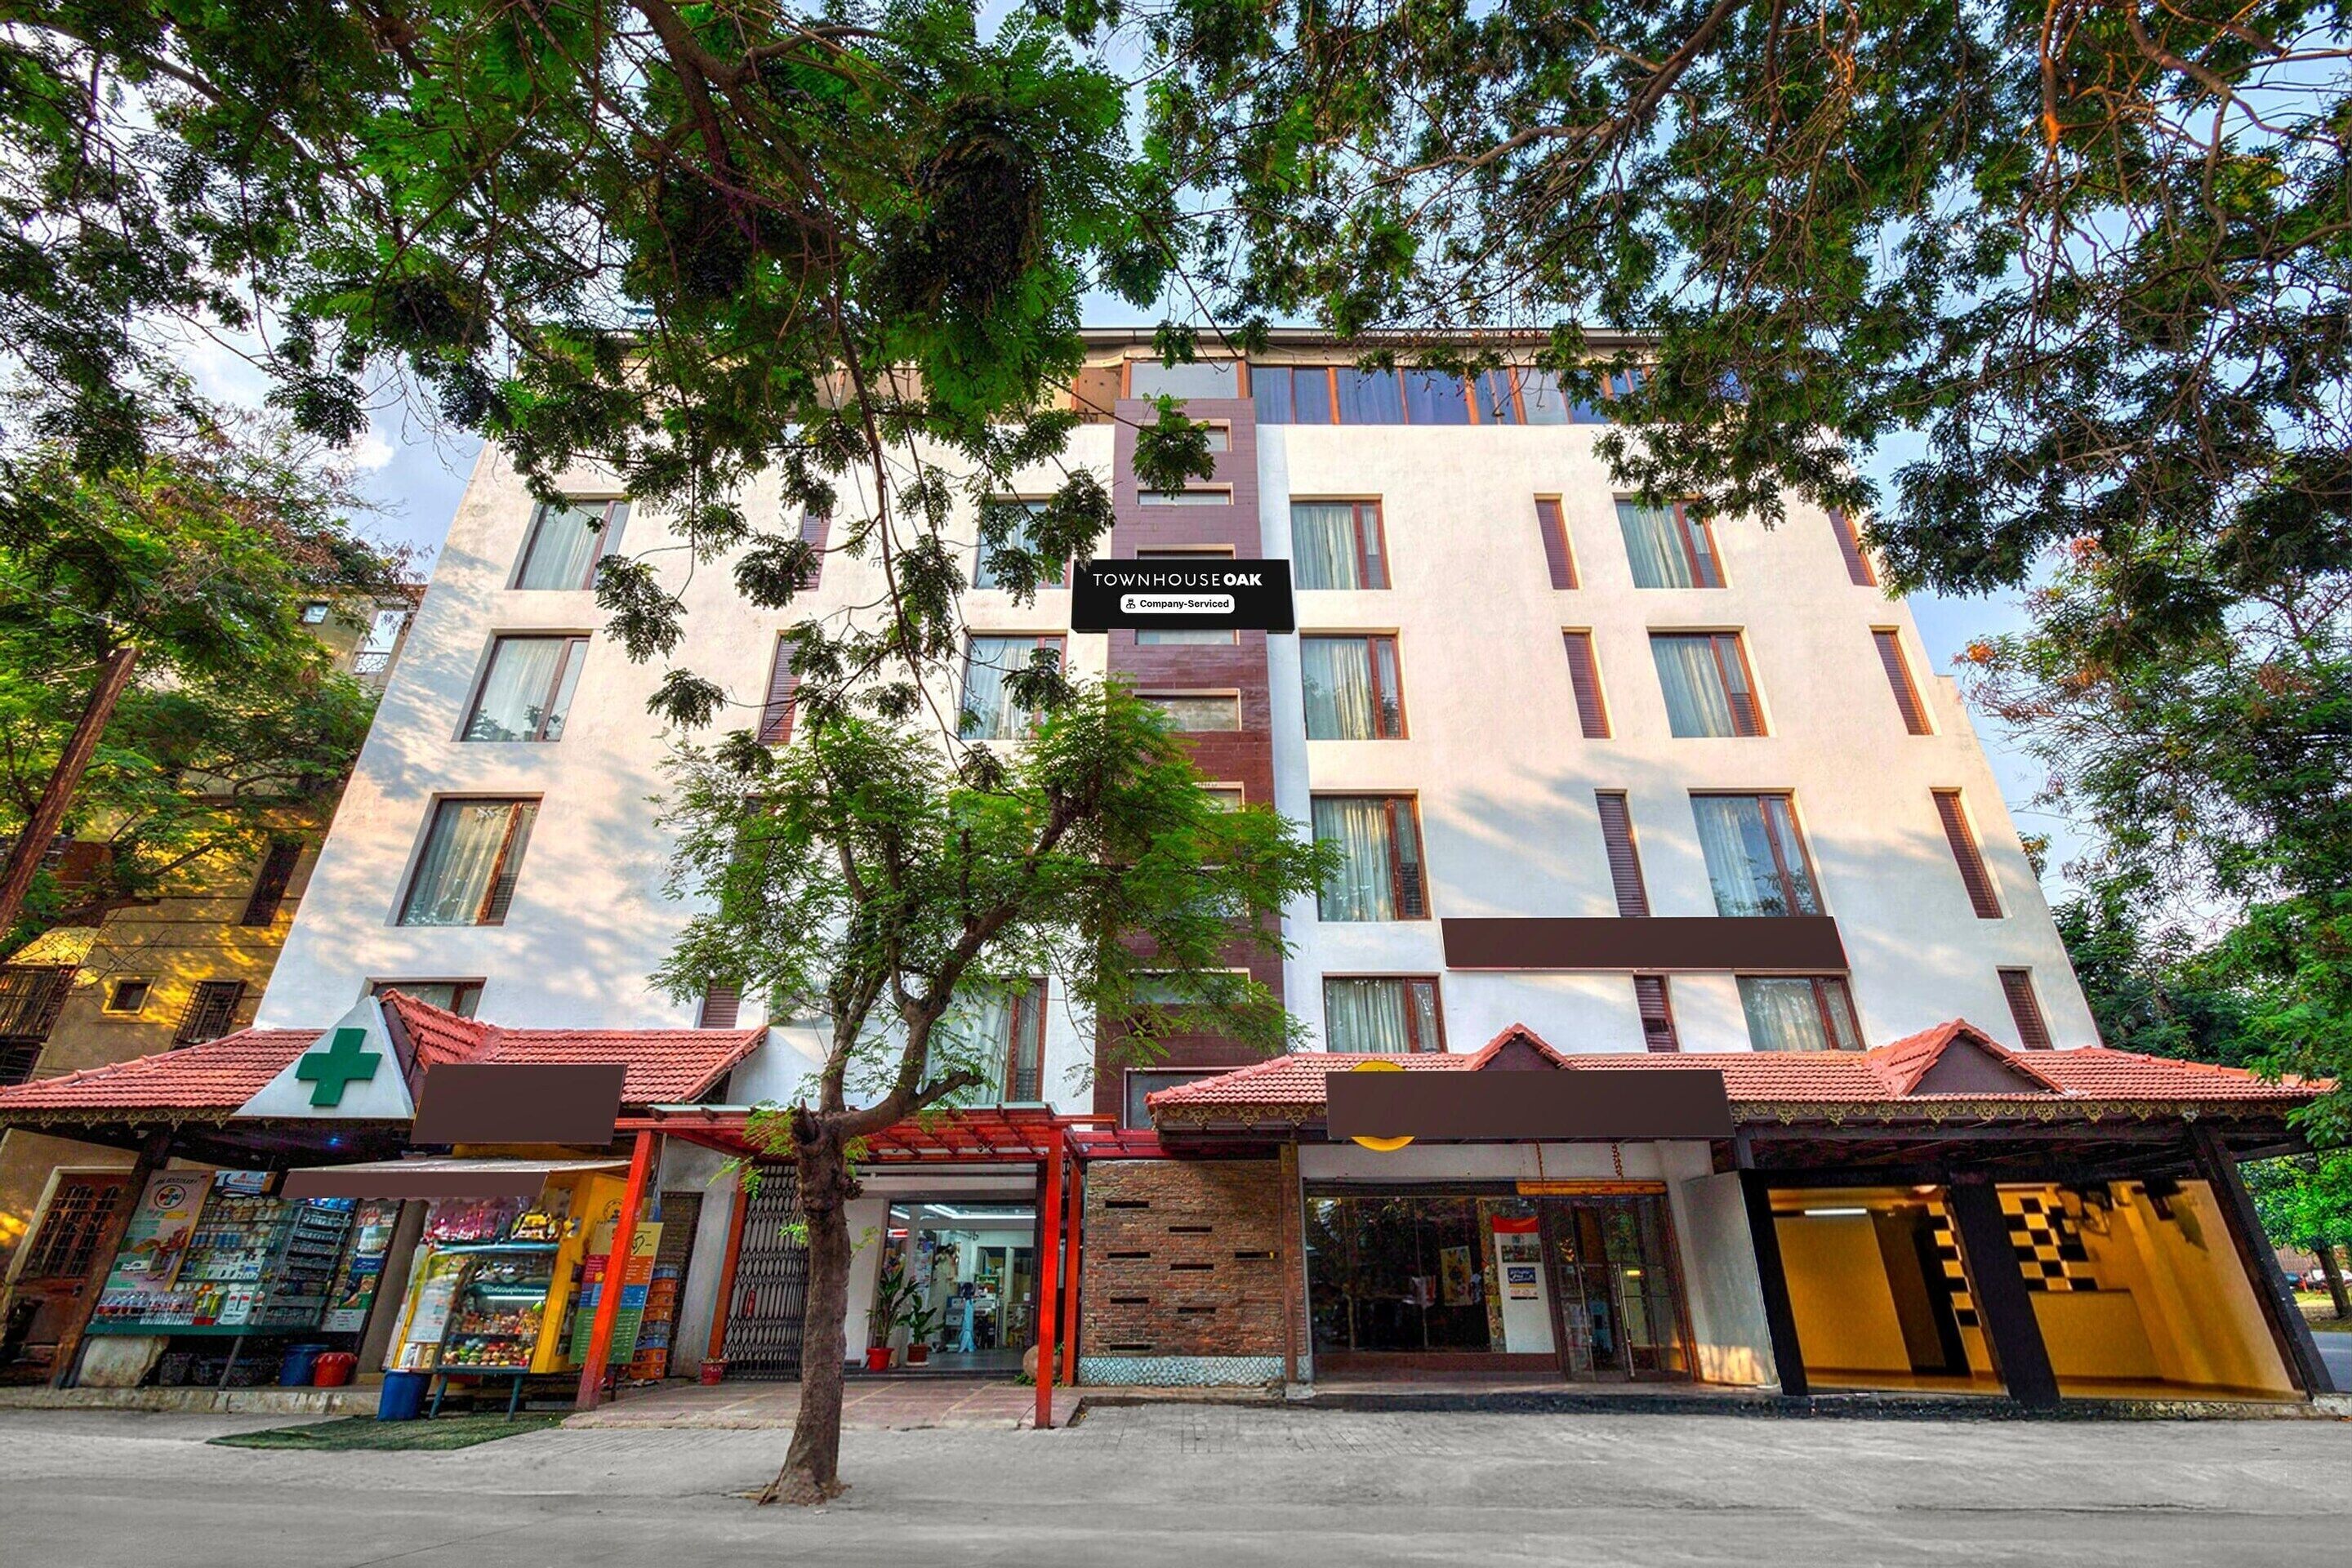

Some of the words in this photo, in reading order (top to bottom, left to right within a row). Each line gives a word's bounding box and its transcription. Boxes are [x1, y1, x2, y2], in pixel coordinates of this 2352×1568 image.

[1093, 573, 1220, 586] TOWNHOUSE
[1223, 573, 1263, 586] OAK
[1140, 599, 1230, 609] Company-Serviced
